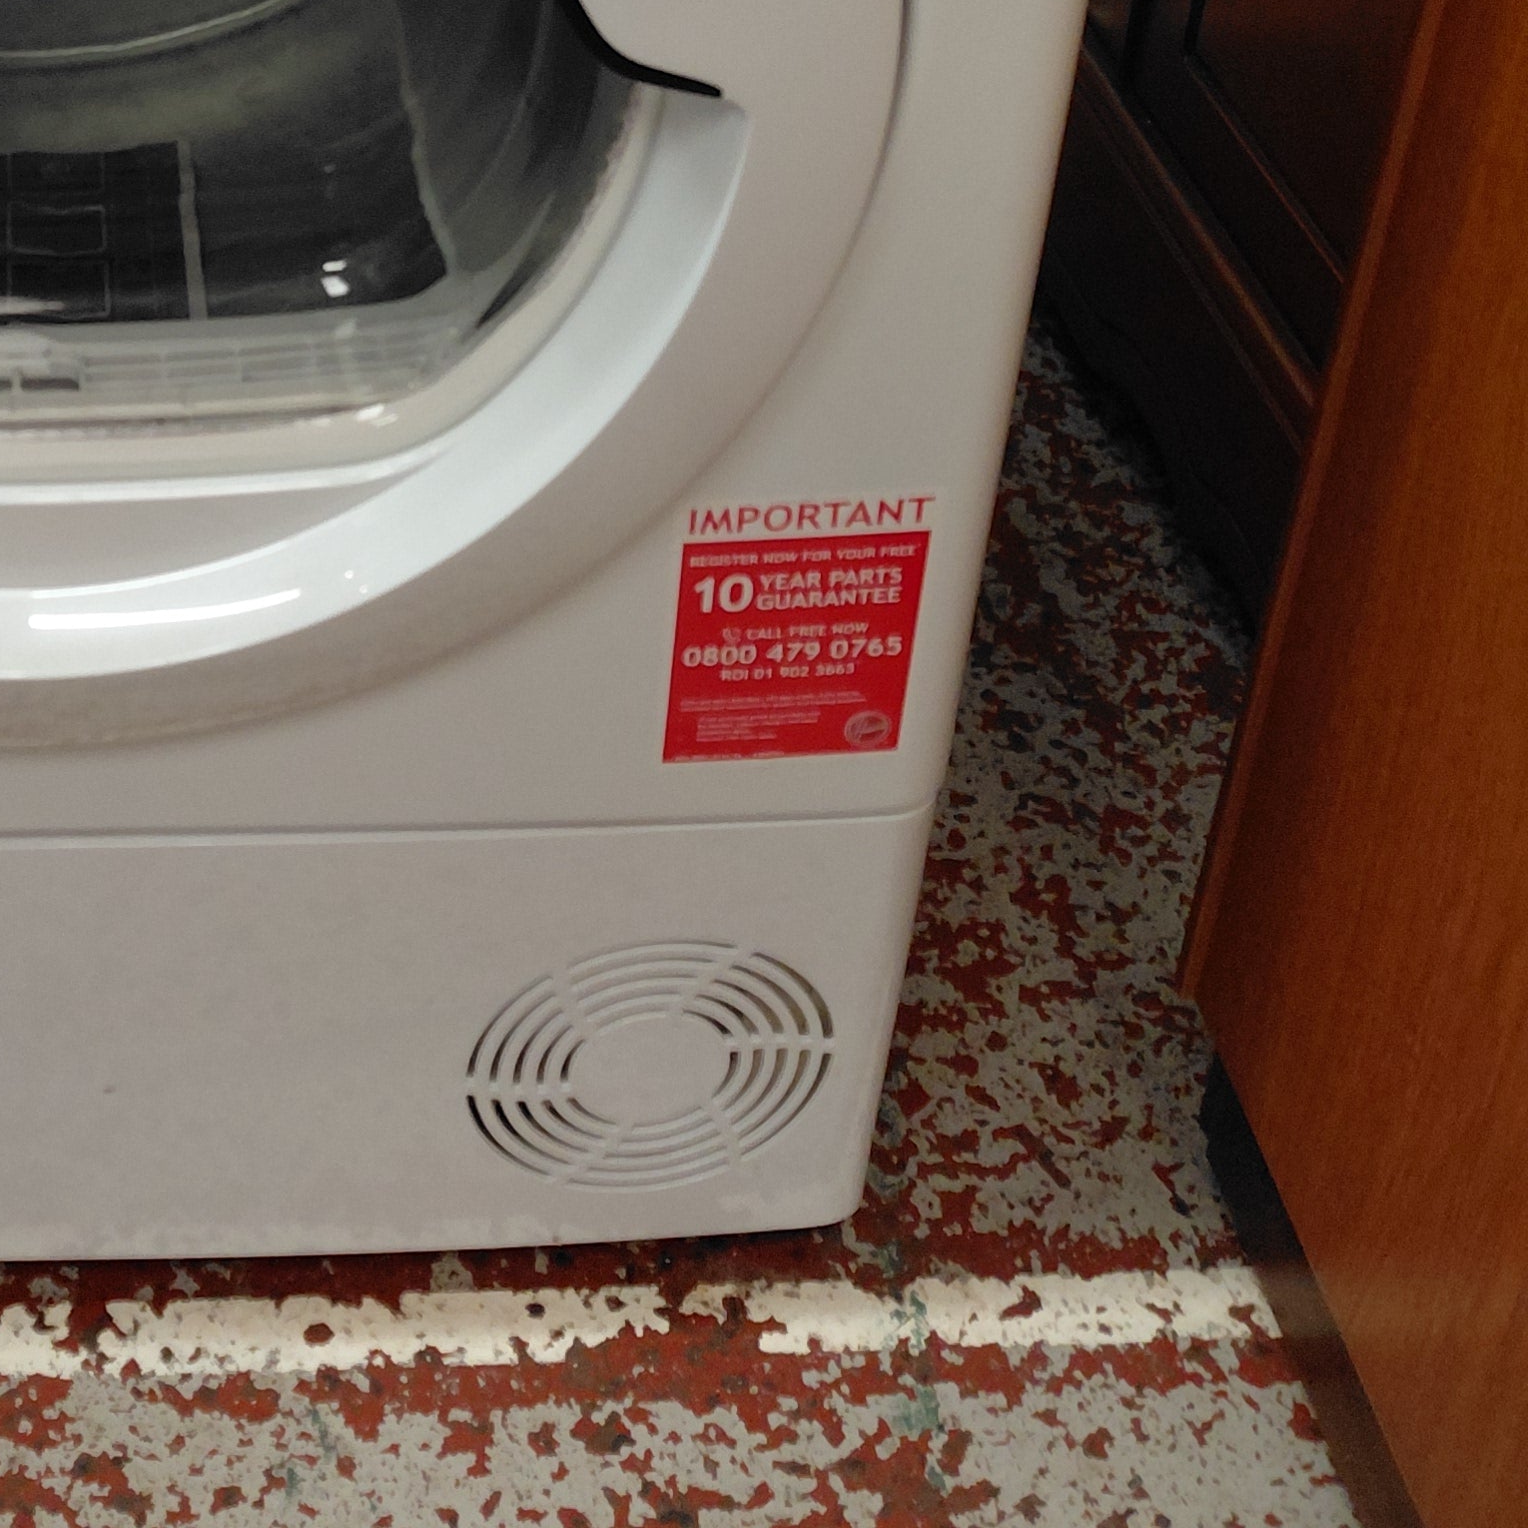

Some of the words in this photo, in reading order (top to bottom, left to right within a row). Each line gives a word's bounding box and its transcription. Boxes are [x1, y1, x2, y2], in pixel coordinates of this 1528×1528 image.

[688, 496, 936, 535] IMPORTANT
[689, 553, 759, 568] REGISTER
[763, 552, 797, 565] NOW
[802, 549, 832, 562] FOR
[837, 547, 876, 561] YOUR
[880, 544, 916, 558] FREE
[759, 571, 822, 591] YEAR
[828, 567, 903, 587] PARTS
[693, 573, 754, 614] 10
[755, 586, 903, 611] GUARANTEE
[746, 628, 782, 641] CALL
[789, 625, 826, 638] FREE
[832, 622, 870, 635] NOW
[682, 644, 758, 667] 0800
[766, 640, 822, 663] 479
[829, 635, 903, 660] 0765
